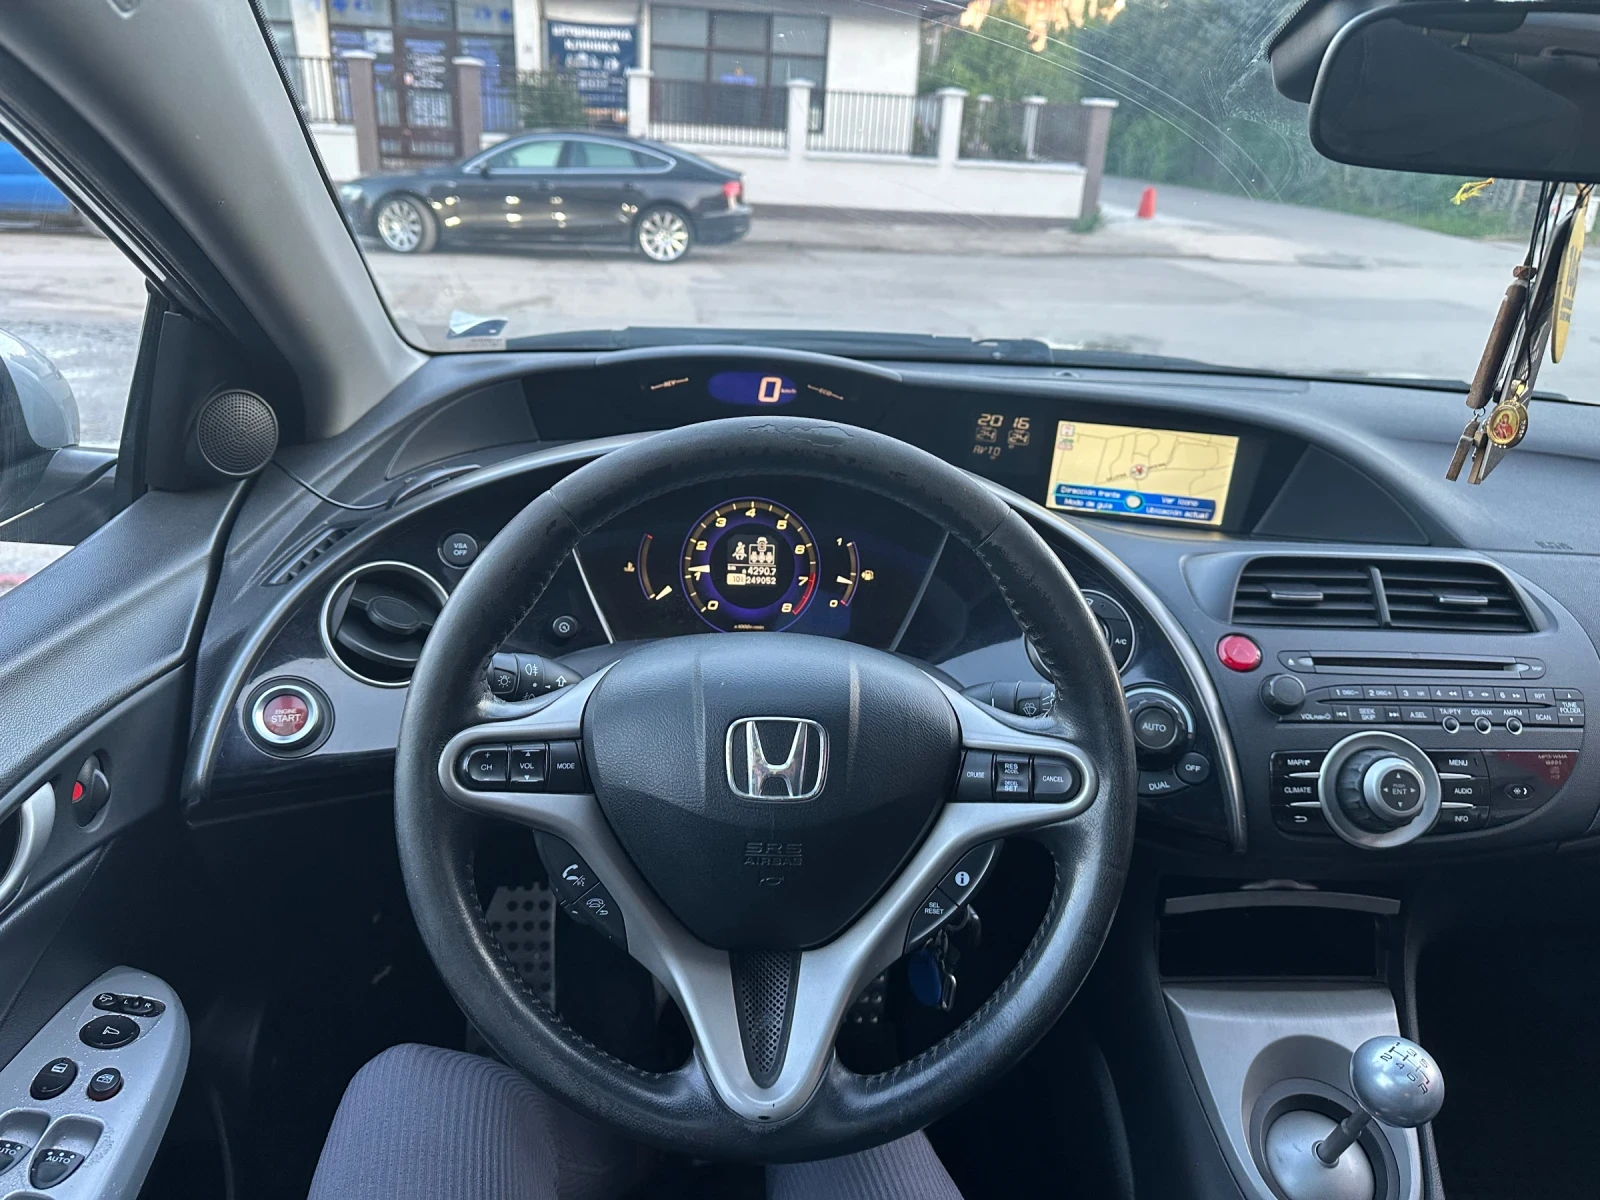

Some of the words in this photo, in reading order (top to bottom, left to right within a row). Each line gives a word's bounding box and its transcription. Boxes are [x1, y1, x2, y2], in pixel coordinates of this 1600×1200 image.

[758, 377, 782, 402] 0
[977, 413, 1004, 427] 20
[1012, 416, 1030, 430] 16
[745, 508, 757, 518] 4
[715, 517, 727, 527] 3
[776, 519, 788, 530] 5
[696, 541, 708, 551] 2
[795, 544, 806, 555] 6
[693, 571, 701, 581] 1
[747, 566, 777, 576] 4290.7
[746, 576, 777, 586] 249052
[798, 576, 808, 586] 7
[707, 600, 719, 610] 0
[781, 603, 792, 613] 8
[1115, 637, 1127, 645] A/C
[1368, 689, 1375, 697] 2
[1468, 690, 1474, 698] 5
[1471, 708, 1493, 716] CD/AUX
[1535, 713, 1552, 721] SCAN
[271, 713, 302, 723] START
[1142, 722, 1167, 733] AUTO
[480, 763, 493, 771] CH
[1185, 764, 1201, 772] OFF
[1448, 759, 1468, 767] MENU
[966, 771, 985, 779] CRUISE
[1042, 775, 1065, 783] CANCEL
[1148, 781, 1171, 790] DUAL
[1284, 786, 1312, 794] CLIMATE
[1454, 787, 1473, 795] AUDIO
[745, 842, 803, 854] SRS
[744, 856, 803, 866] AIRBAG
[928, 901, 941, 909] SEL
[924, 907, 944, 915] RESET
[1395, 1062, 1405, 1070] 4
[1417, 1082, 1429, 1095] R
[46, 1155, 71, 1165] AUTO
